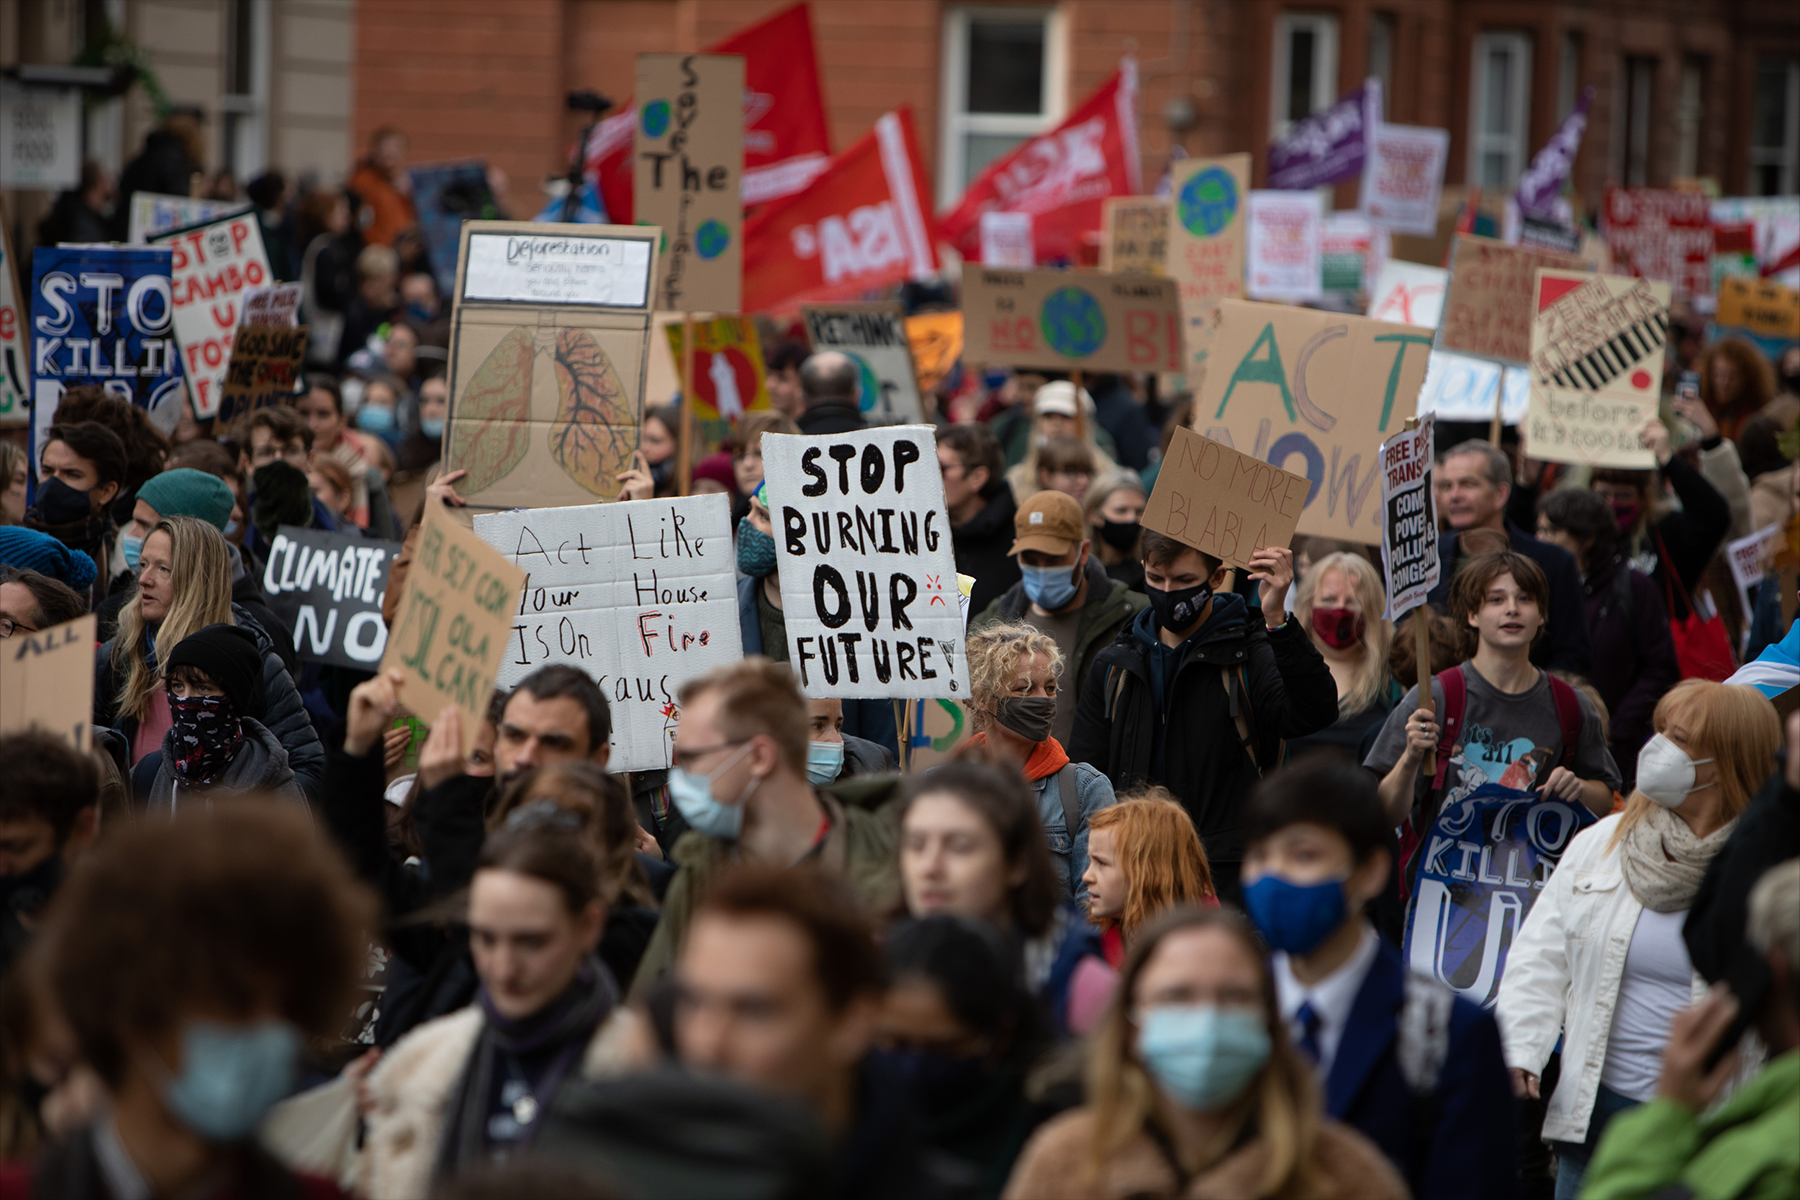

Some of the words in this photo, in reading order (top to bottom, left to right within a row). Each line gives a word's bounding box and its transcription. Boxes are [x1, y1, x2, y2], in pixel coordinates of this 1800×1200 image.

[641, 151, 729, 191] The
[506, 236, 611, 264] Deforestation
[172, 259, 264, 309] CAMBO
[1214, 321, 1433, 434] ACT
[1548, 389, 1640, 425] before
[801, 439, 920, 497] STOP
[1385, 439, 1411, 471] FREE
[1179, 437, 1221, 481] NO
[1229, 455, 1302, 520] MORE
[515, 525, 592, 566] Act
[782, 503, 941, 556] BURNING
[264, 534, 386, 604] CLIMATE
[633, 569, 708, 607] House
[812, 563, 918, 632] OUR
[15, 624, 80, 661] ALL
[636, 609, 711, 657] Fire
[796, 632, 959, 692] FUTURE!
[1463, 720, 1494, 744] its
[1482, 741, 1514, 766] all
